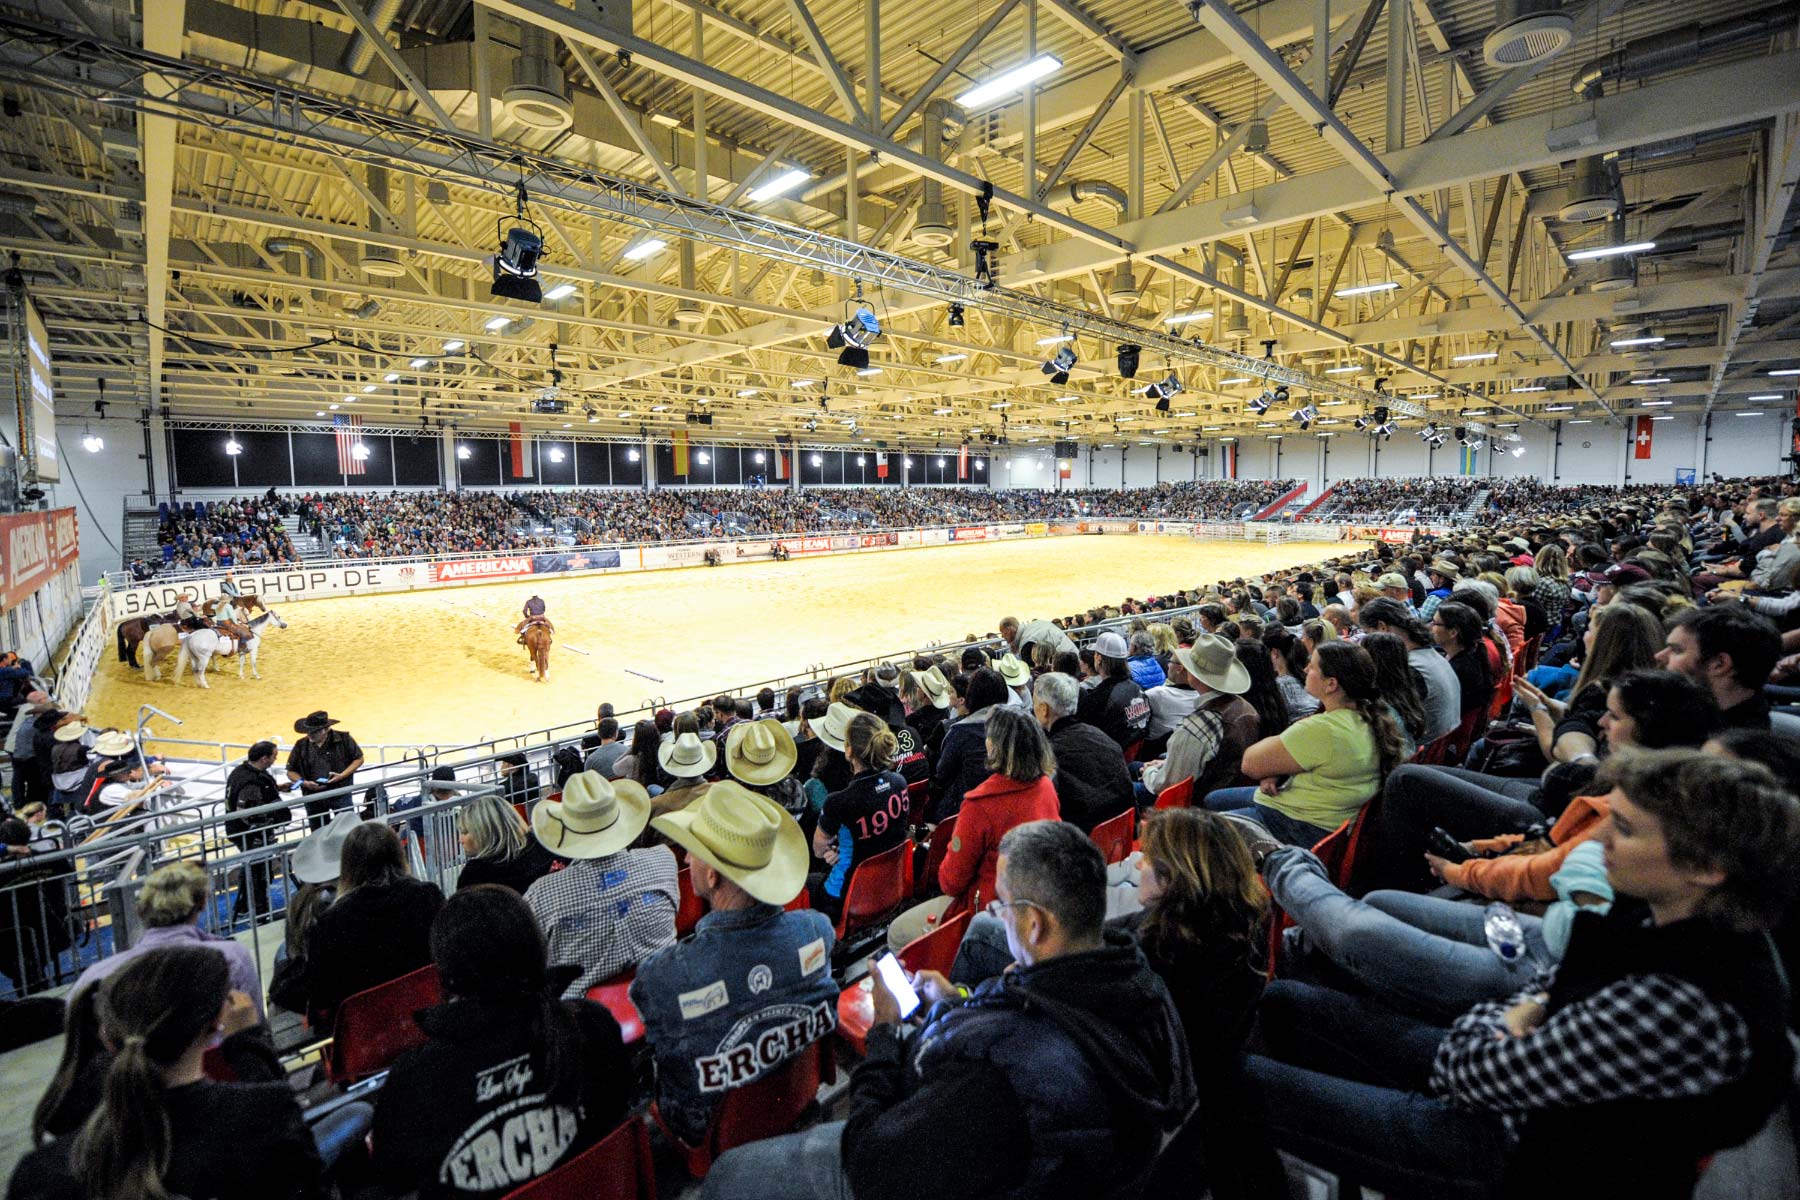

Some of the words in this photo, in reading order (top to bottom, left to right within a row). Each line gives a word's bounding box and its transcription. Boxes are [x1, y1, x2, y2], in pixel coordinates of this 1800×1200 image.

[440, 558, 531, 579] AMERICANA
[856, 788, 910, 840] 1905
[695, 1000, 835, 1092] ERCHA
